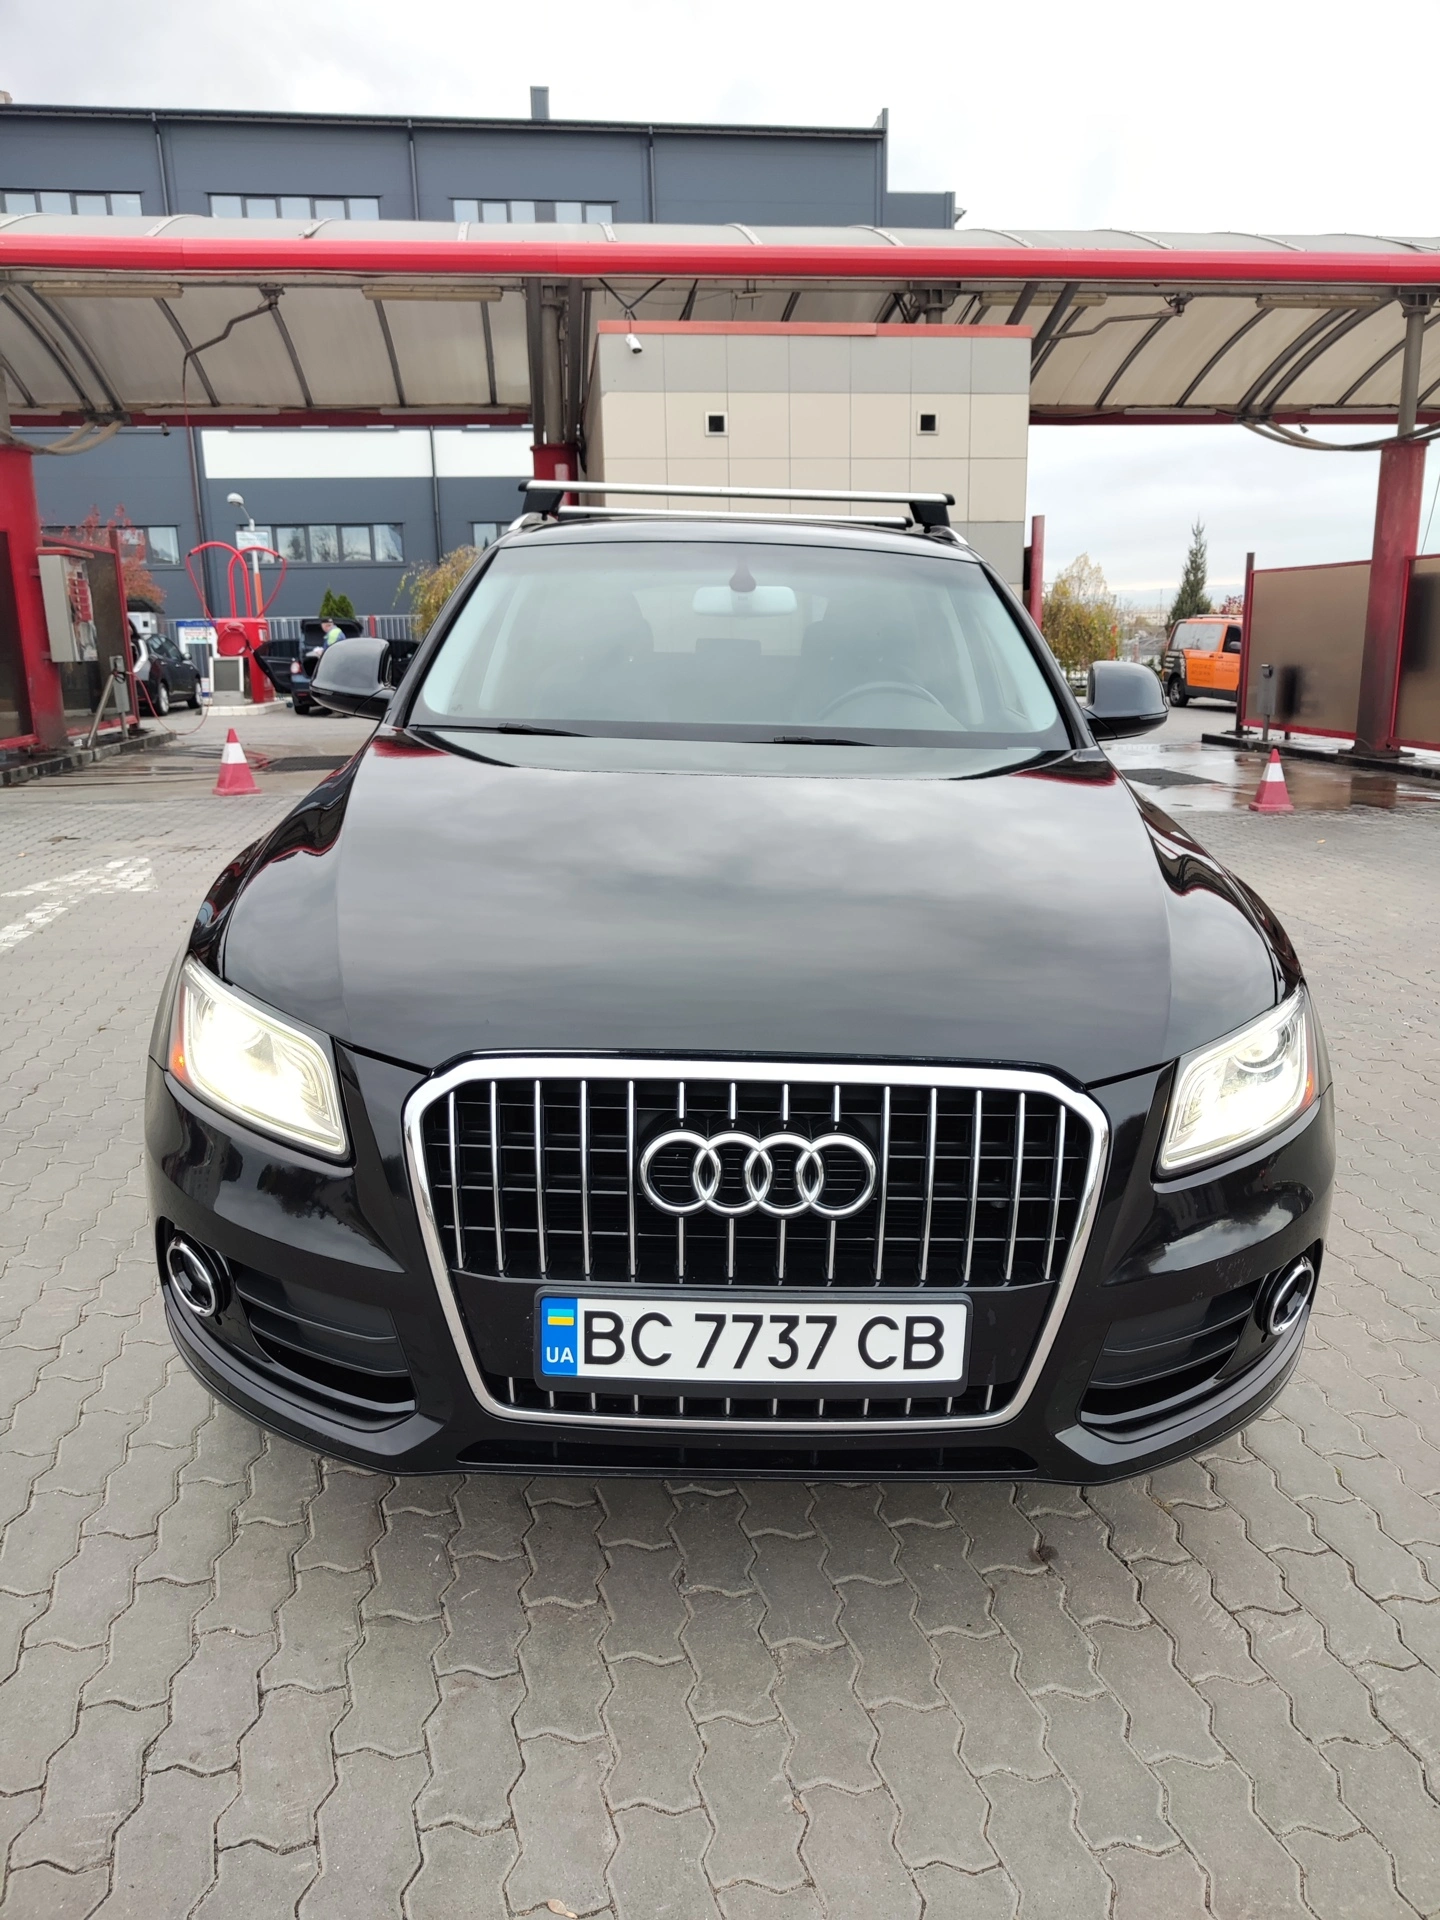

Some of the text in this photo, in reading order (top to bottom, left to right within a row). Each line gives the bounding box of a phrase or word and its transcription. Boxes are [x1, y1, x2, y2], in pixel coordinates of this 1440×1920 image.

[546, 1346, 574, 1363] UA
[584, 1310, 945, 1370] BC 7737 CB
